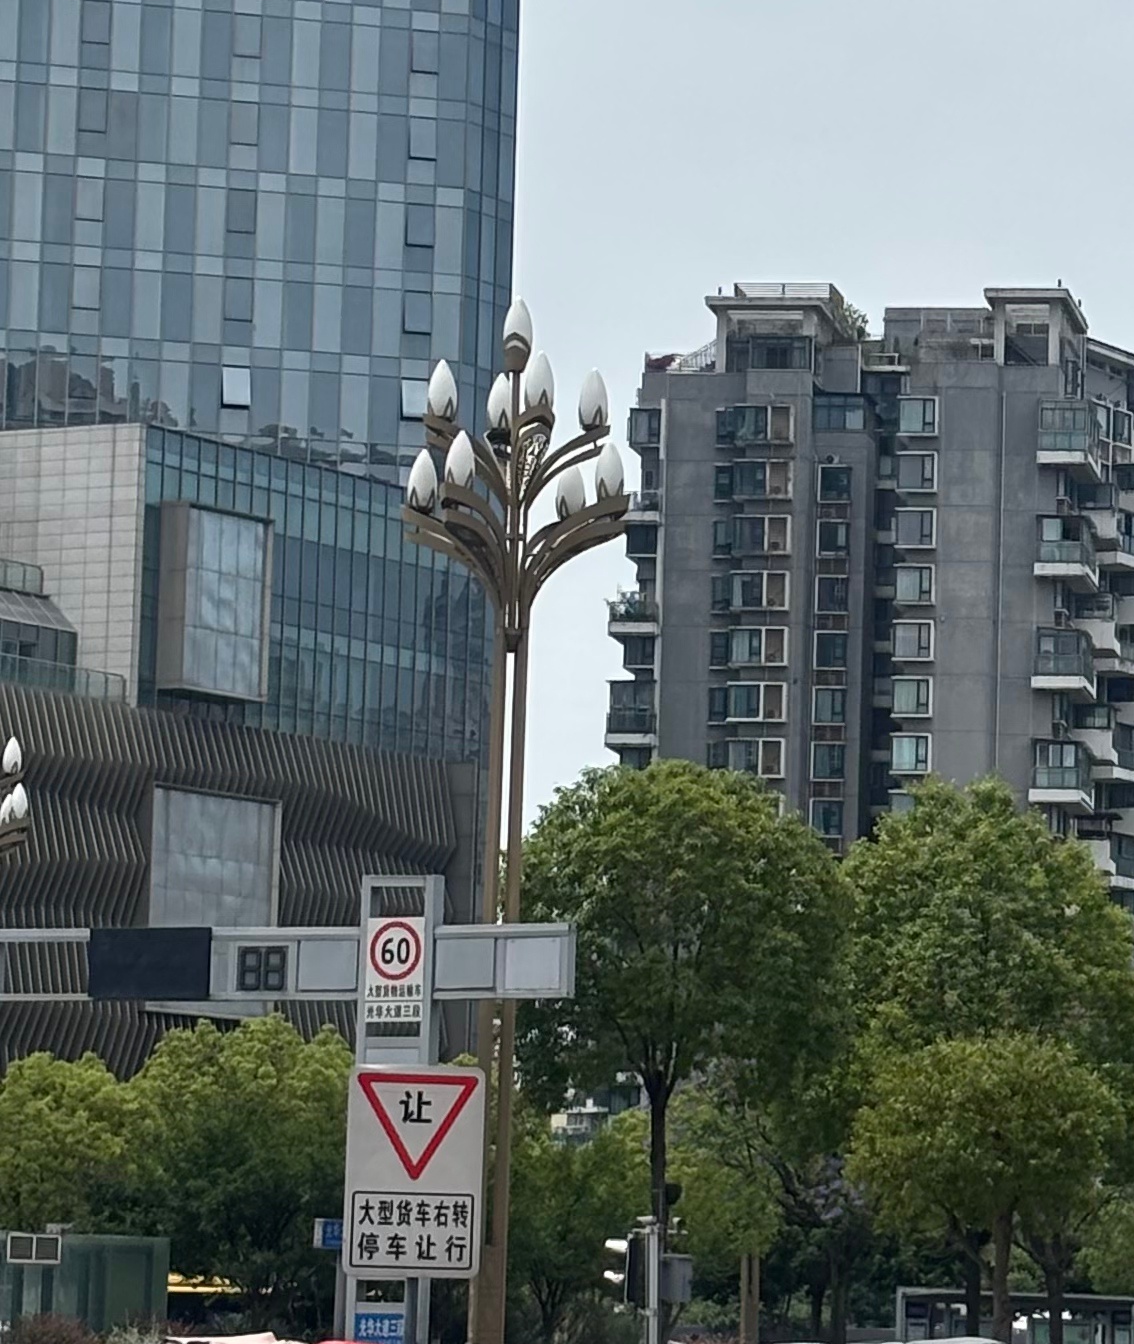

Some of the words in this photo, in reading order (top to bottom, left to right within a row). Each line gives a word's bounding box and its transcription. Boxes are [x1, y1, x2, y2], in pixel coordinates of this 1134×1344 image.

[381, 937, 410, 965] 60
[366, 1004, 421, 1019] 光华大道三段
[399, 1091, 432, 1125] 让
[358, 1199, 468, 1228] 大型货车右转
[358, 1232, 467, 1262] 停车让行
